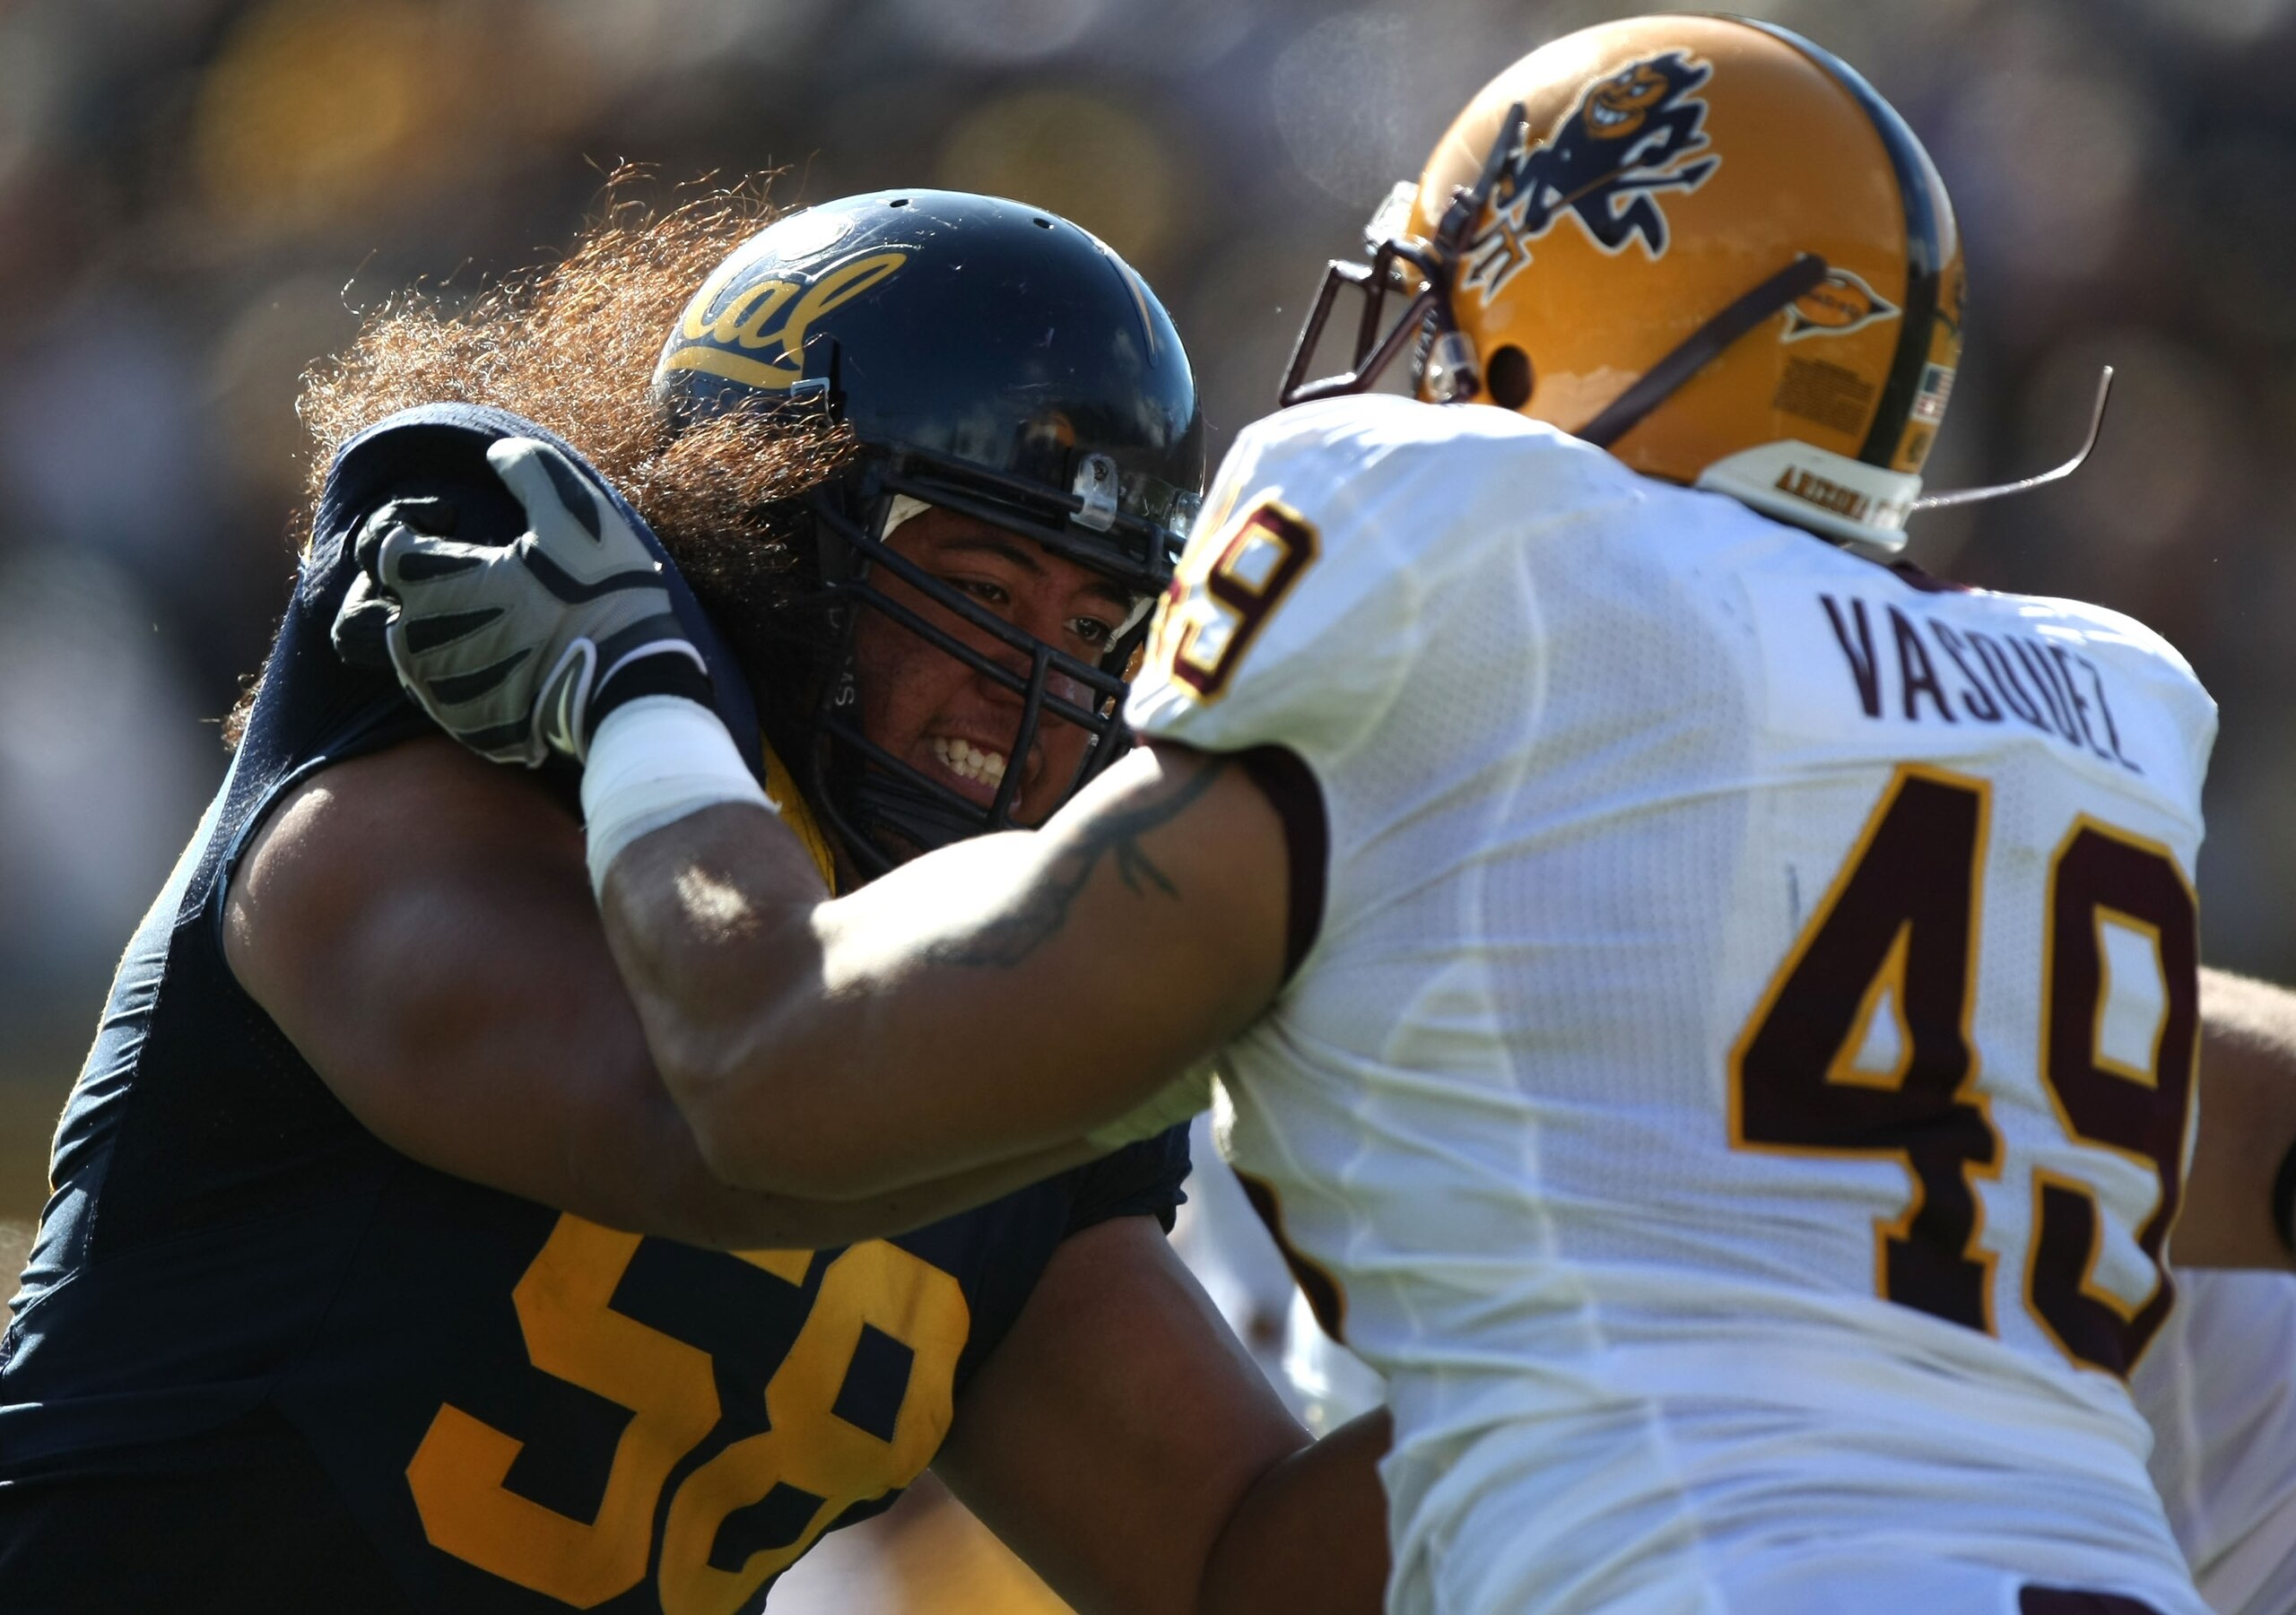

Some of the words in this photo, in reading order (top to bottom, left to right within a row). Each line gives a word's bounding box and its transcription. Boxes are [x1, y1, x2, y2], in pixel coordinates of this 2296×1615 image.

[671, 252, 908, 387] Cal
[1819, 593, 2144, 775] VASQUEZ
[1727, 762, 2200, 1385] 49
[405, 1211, 970, 1615] 58
